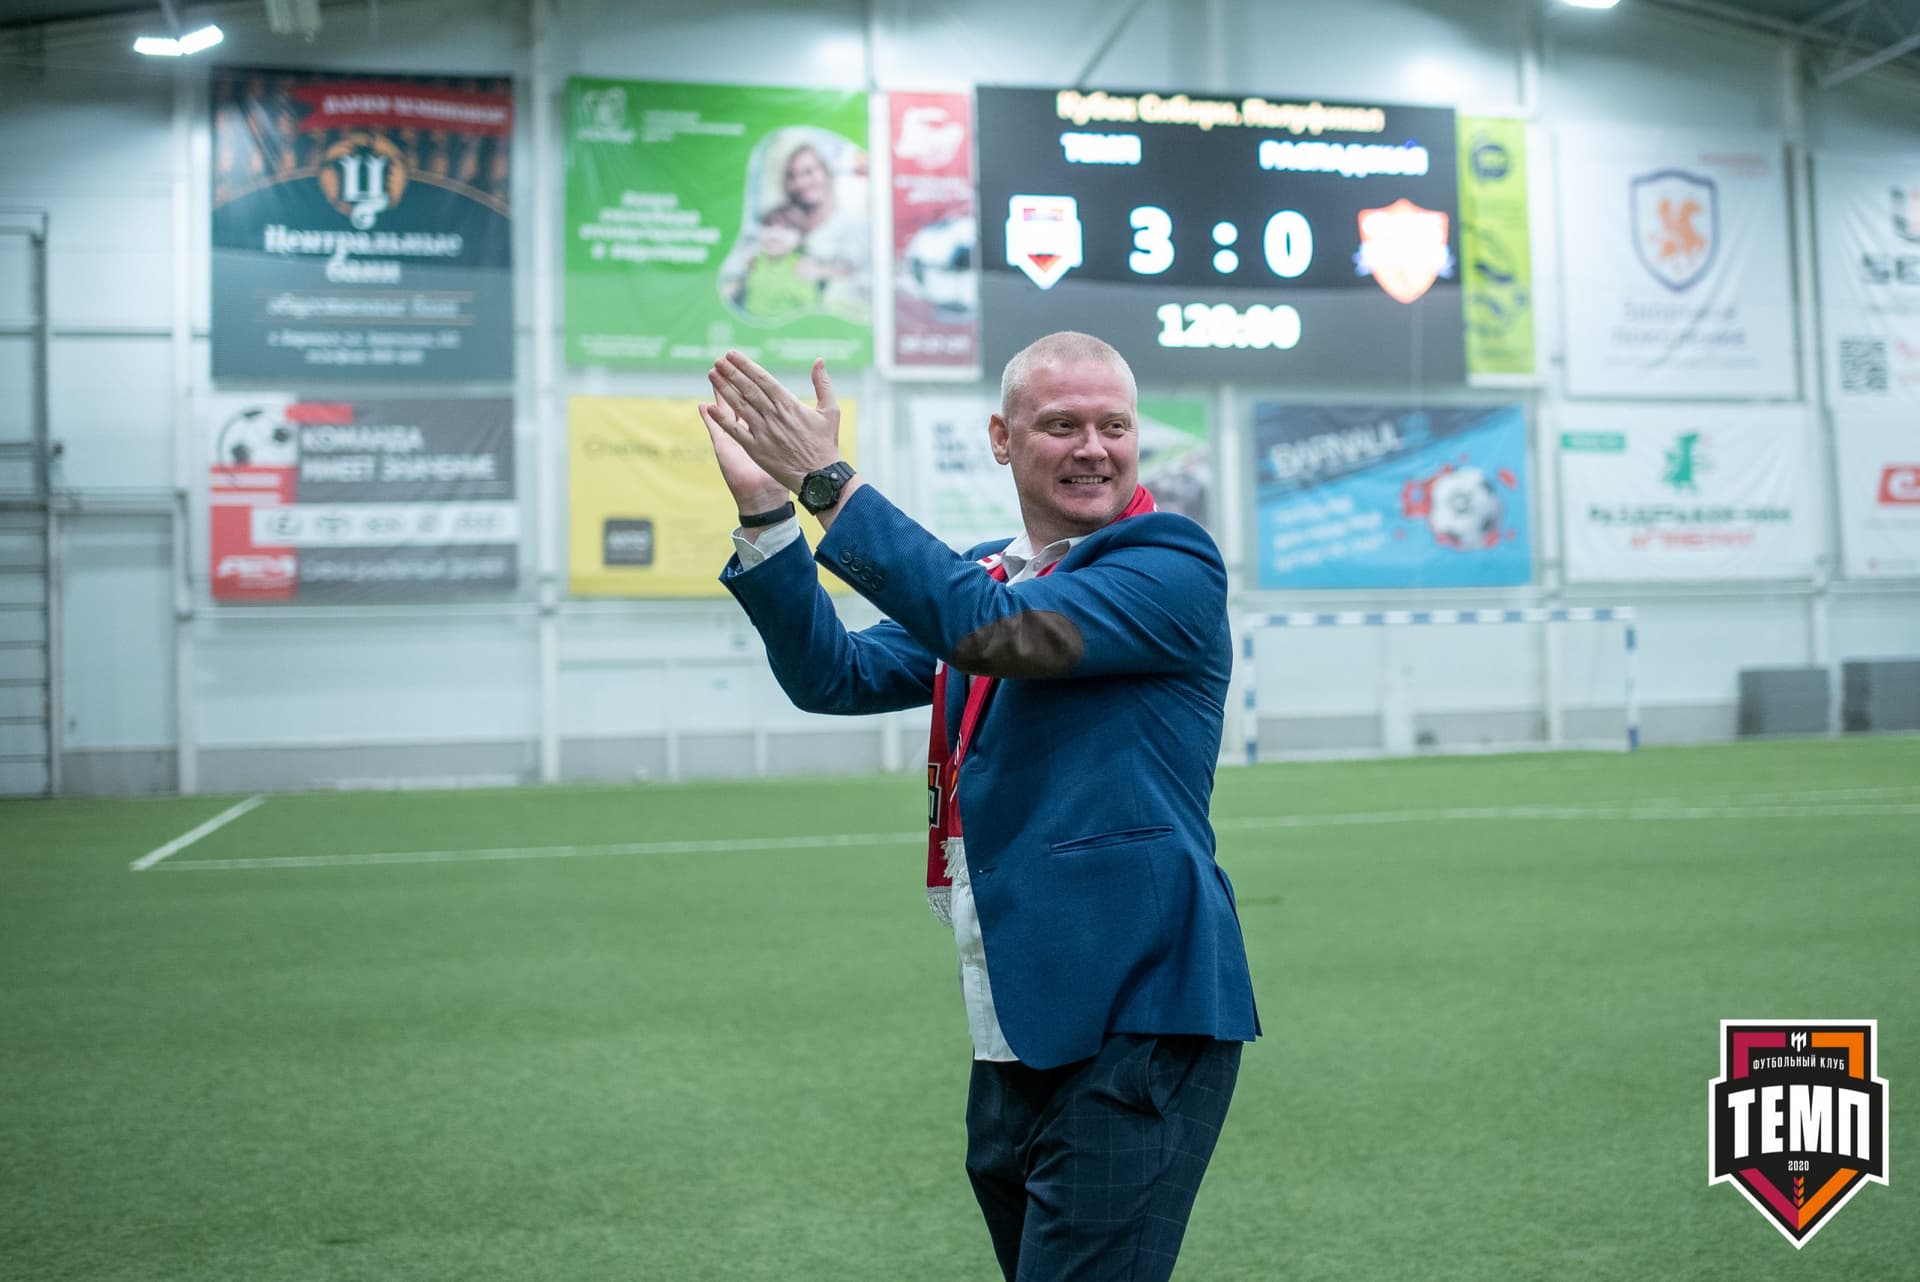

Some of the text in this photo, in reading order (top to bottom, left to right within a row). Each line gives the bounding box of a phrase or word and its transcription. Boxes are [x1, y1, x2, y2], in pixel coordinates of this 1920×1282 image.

[264, 224, 463, 257] Центральные
[1128, 206, 1175, 275] 3
[1264, 210, 1313, 278] 0
[325, 255, 402, 284] бани
[1157, 303, 1300, 349] 120:00
[303, 425, 424, 453] КОМАНДА
[303, 455, 375, 481] ИМЕЕТ
[383, 453, 496, 481] ЗНАЧЕНИЕ
